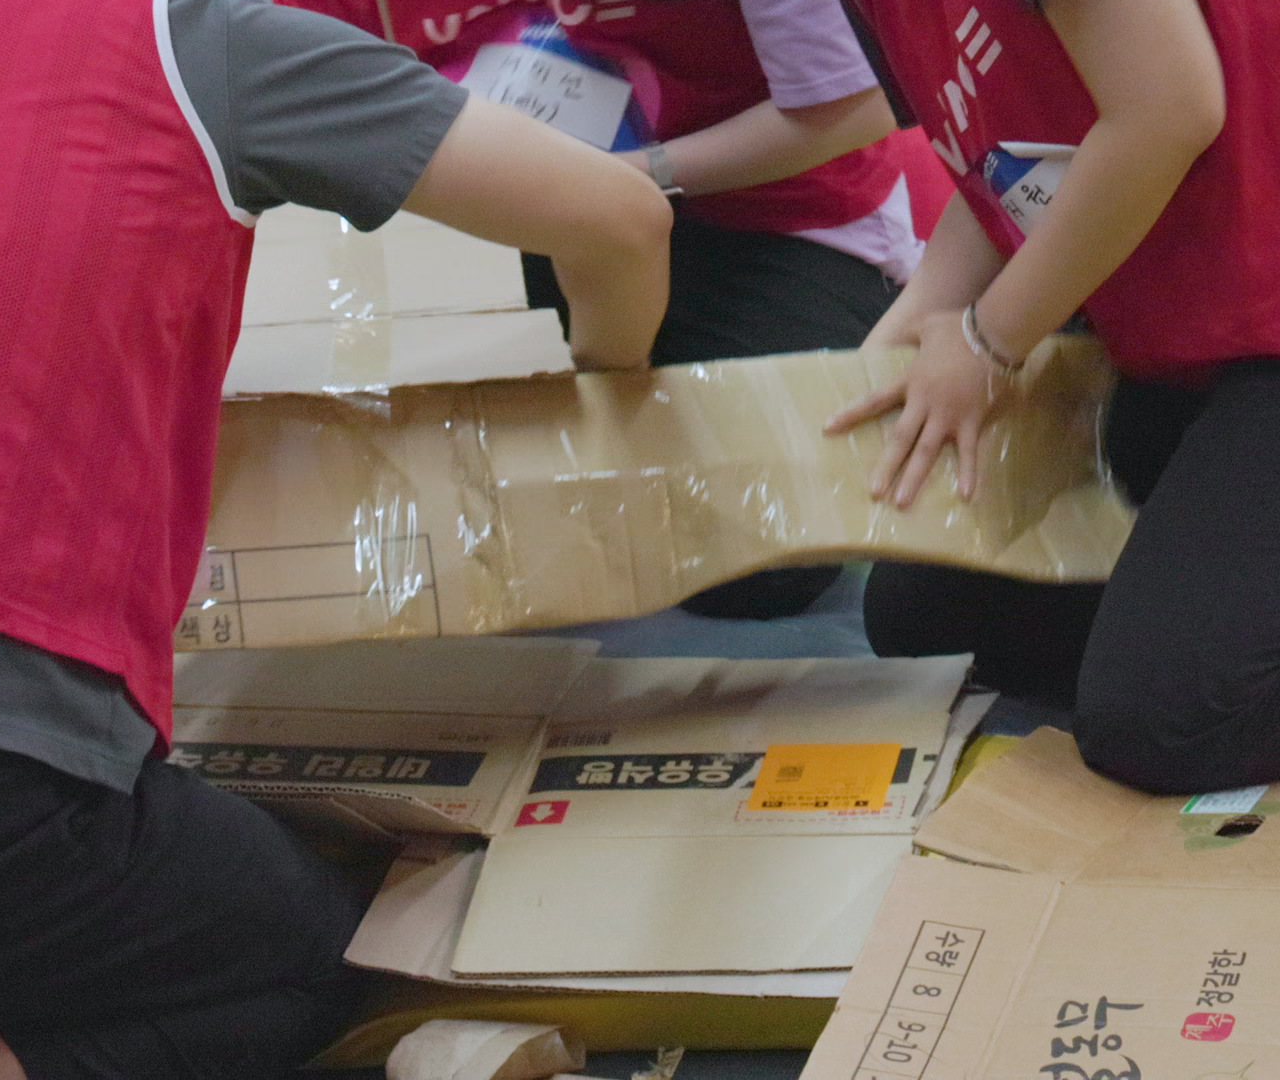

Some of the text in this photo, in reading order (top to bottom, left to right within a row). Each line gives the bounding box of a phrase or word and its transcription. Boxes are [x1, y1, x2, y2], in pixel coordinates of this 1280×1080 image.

[575, 759, 734, 785] 우유식빵
[882, 931, 965, 1063] 수량 8 9-10
[1184, 949, 1247, 1041] 제주 정갈한
